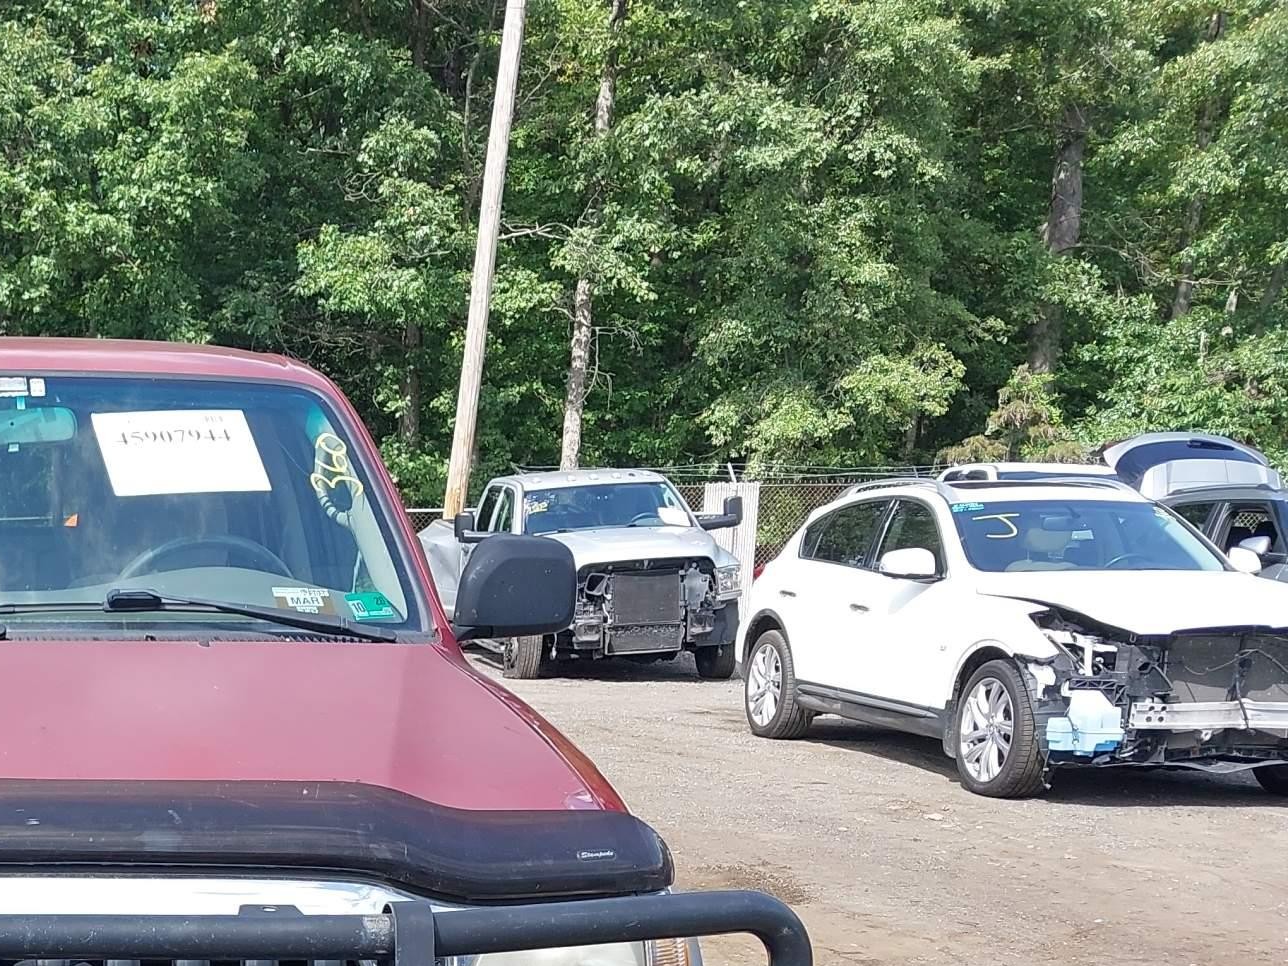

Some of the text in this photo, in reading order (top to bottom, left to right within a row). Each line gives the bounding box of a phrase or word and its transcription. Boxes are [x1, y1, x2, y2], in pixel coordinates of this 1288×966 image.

[972, 513, 1020, 539] J
[290, 597, 320, 606] MAR
[352, 602, 366, 613] 10
